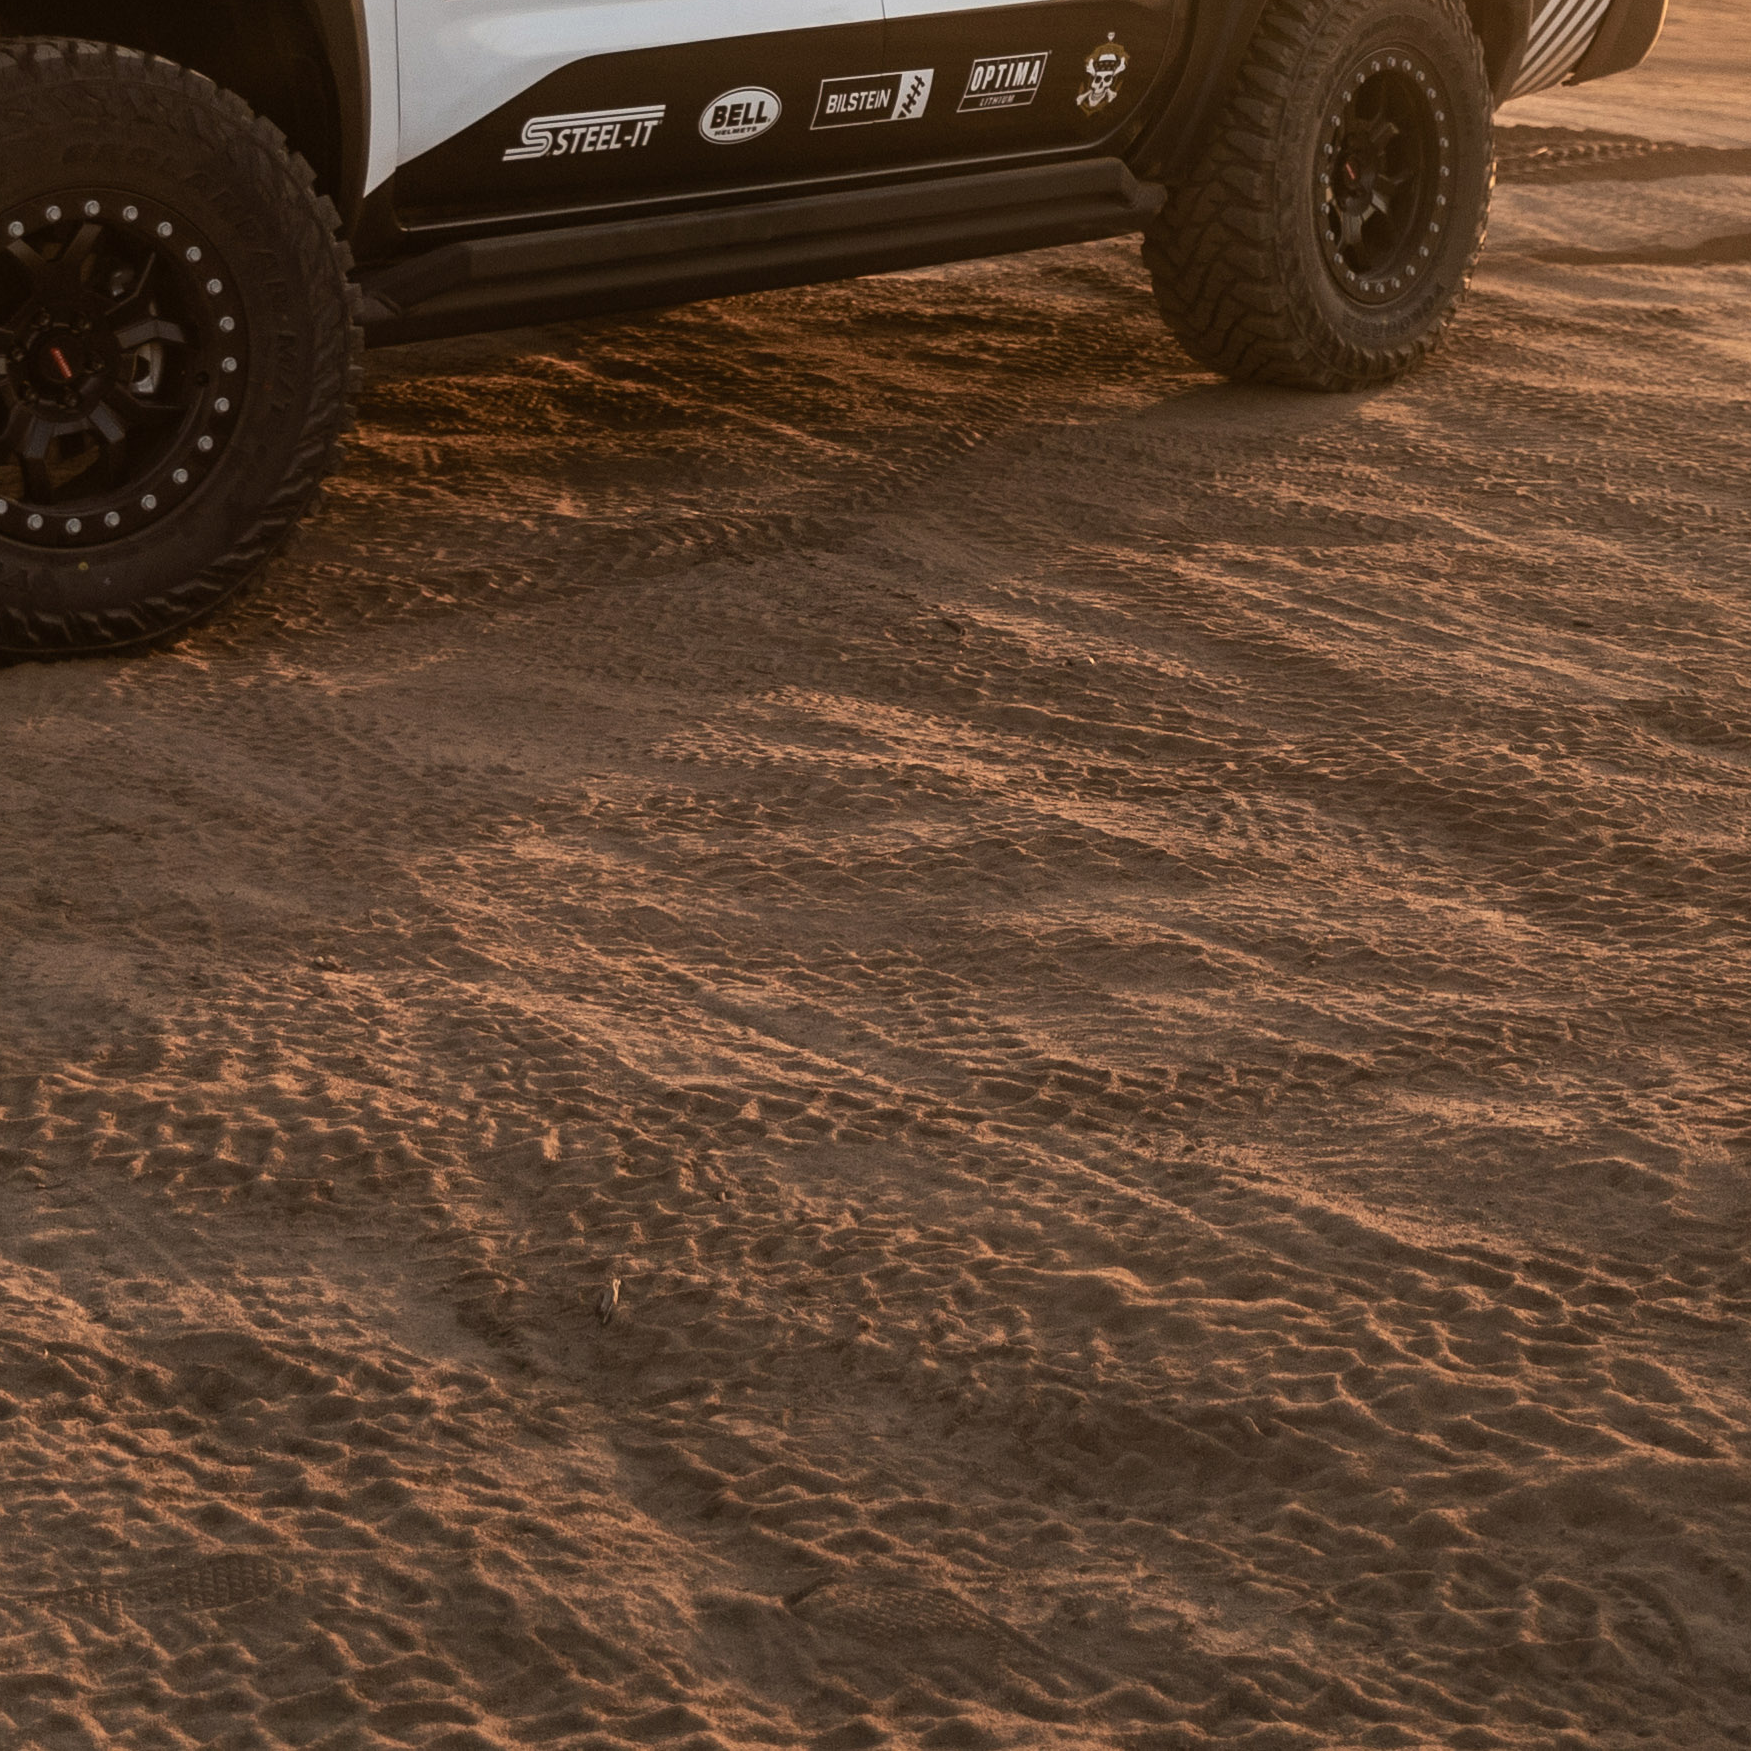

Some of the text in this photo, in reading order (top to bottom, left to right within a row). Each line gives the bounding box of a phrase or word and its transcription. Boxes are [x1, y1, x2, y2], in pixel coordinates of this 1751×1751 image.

[970, 60, 1041, 91] OPTIMA
[710, 100, 762, 129] BELL
[824, 87, 892, 115] BILSTEIN
[979, 94, 1015, 107] LITHIUM
[552, 119, 659, 156] STEEL-IT
[713, 126, 757, 136] HELMETS
